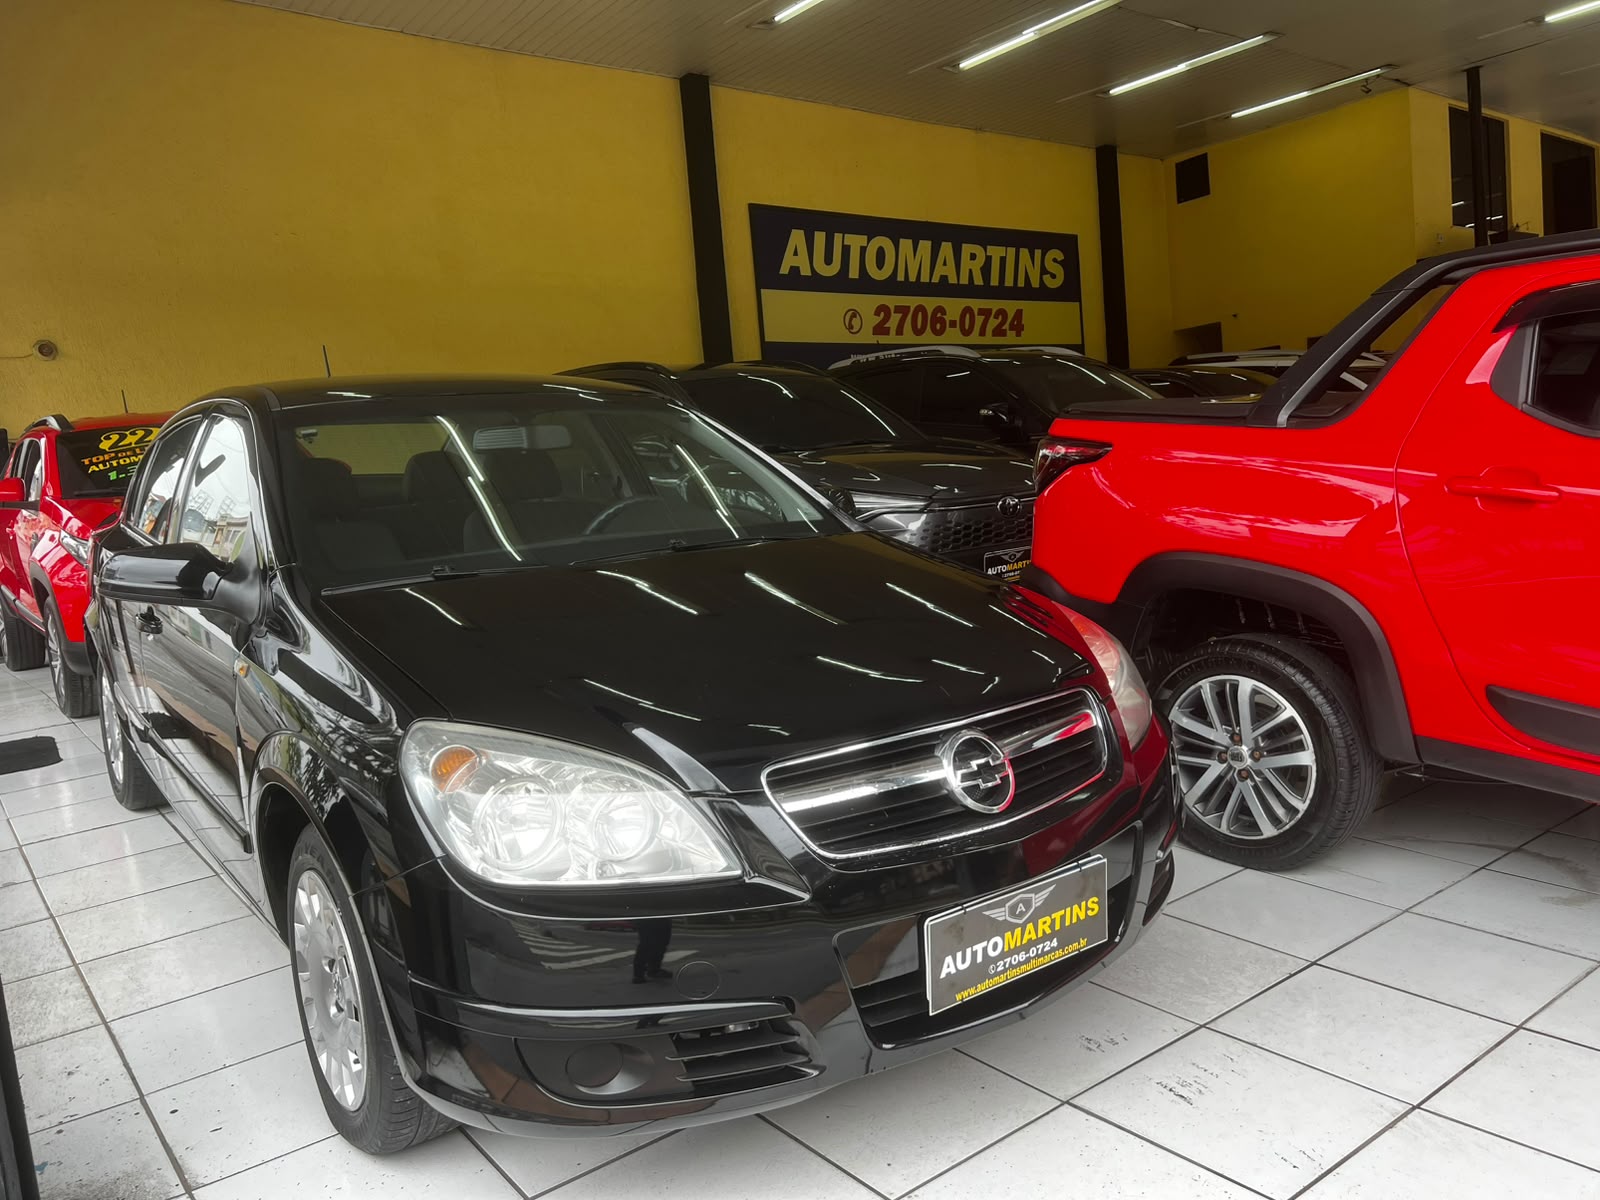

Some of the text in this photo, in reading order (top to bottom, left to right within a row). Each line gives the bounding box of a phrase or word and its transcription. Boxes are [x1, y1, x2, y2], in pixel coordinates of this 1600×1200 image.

[779, 229, 1065, 288] AUTOMARTINS
[872, 304, 1025, 337] 2706-0724
[100, 427, 158, 452] 22
[81, 453, 115, 465] TOP
[1015, 903, 1026, 914] A
[939, 896, 1100, 979] AUTOMARTINS
[955, 937, 1088, 1001] www.automartinsmultimarcas.com.br
[996, 938, 1058, 971] 2706-0724
